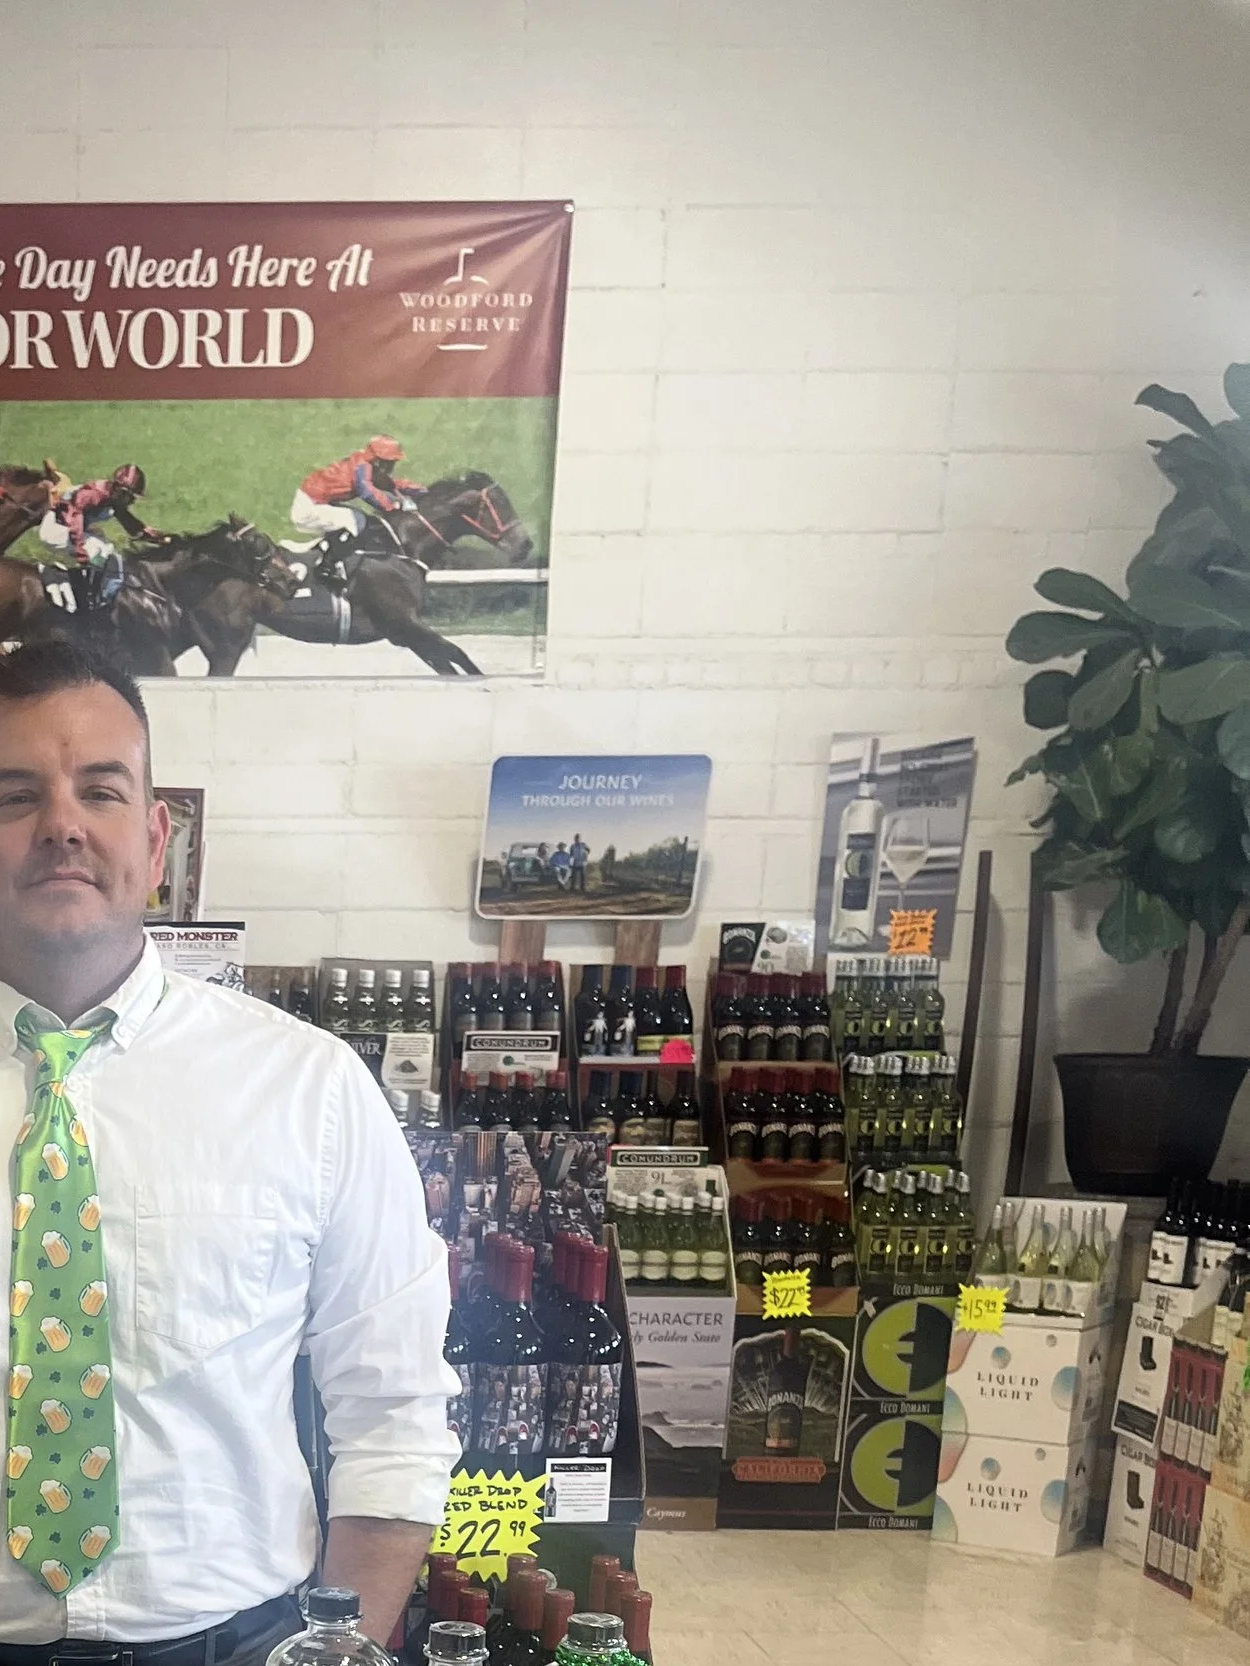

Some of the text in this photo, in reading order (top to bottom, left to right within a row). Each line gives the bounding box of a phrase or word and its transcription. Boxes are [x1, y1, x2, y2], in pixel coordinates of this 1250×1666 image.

[14, 245, 97, 302] Day
[105, 244, 219, 288] Needs
[225, 244, 315, 288] Here
[325, 242, 374, 292] At
[399, 292, 534, 309] WOODFORD
[412, 315, 522, 332] RESERVE
[61, 306, 315, 369] WORLD
[558, 774, 642, 790] JOURNEY
[522, 795, 591, 807] THROUGH
[594, 794, 626, 807] OUR
[150, 931, 239, 942] RED MONSTER
[474, 1037, 547, 1049] CONUNDRUM
[621, 1153, 695, 1163] CONUNDRUM
[629, 1311, 723, 1326] CHARACTER
[647, 1331, 688, 1343] Golden
[977, 1371, 1040, 1387] LIQUID
[980, 1386, 1034, 1401] LIGHT
[584, 1464, 606, 1472] DROP
[737, 1463, 821, 1477] CALIFORNIA
[487, 1485, 522, 1497] DROP
[967, 1482, 1029, 1499] LIQUID
[478, 1500, 528, 1512] BLEND
[970, 1496, 1023, 1513] LIGHT
[646, 1507, 687, 1520] Caymus
